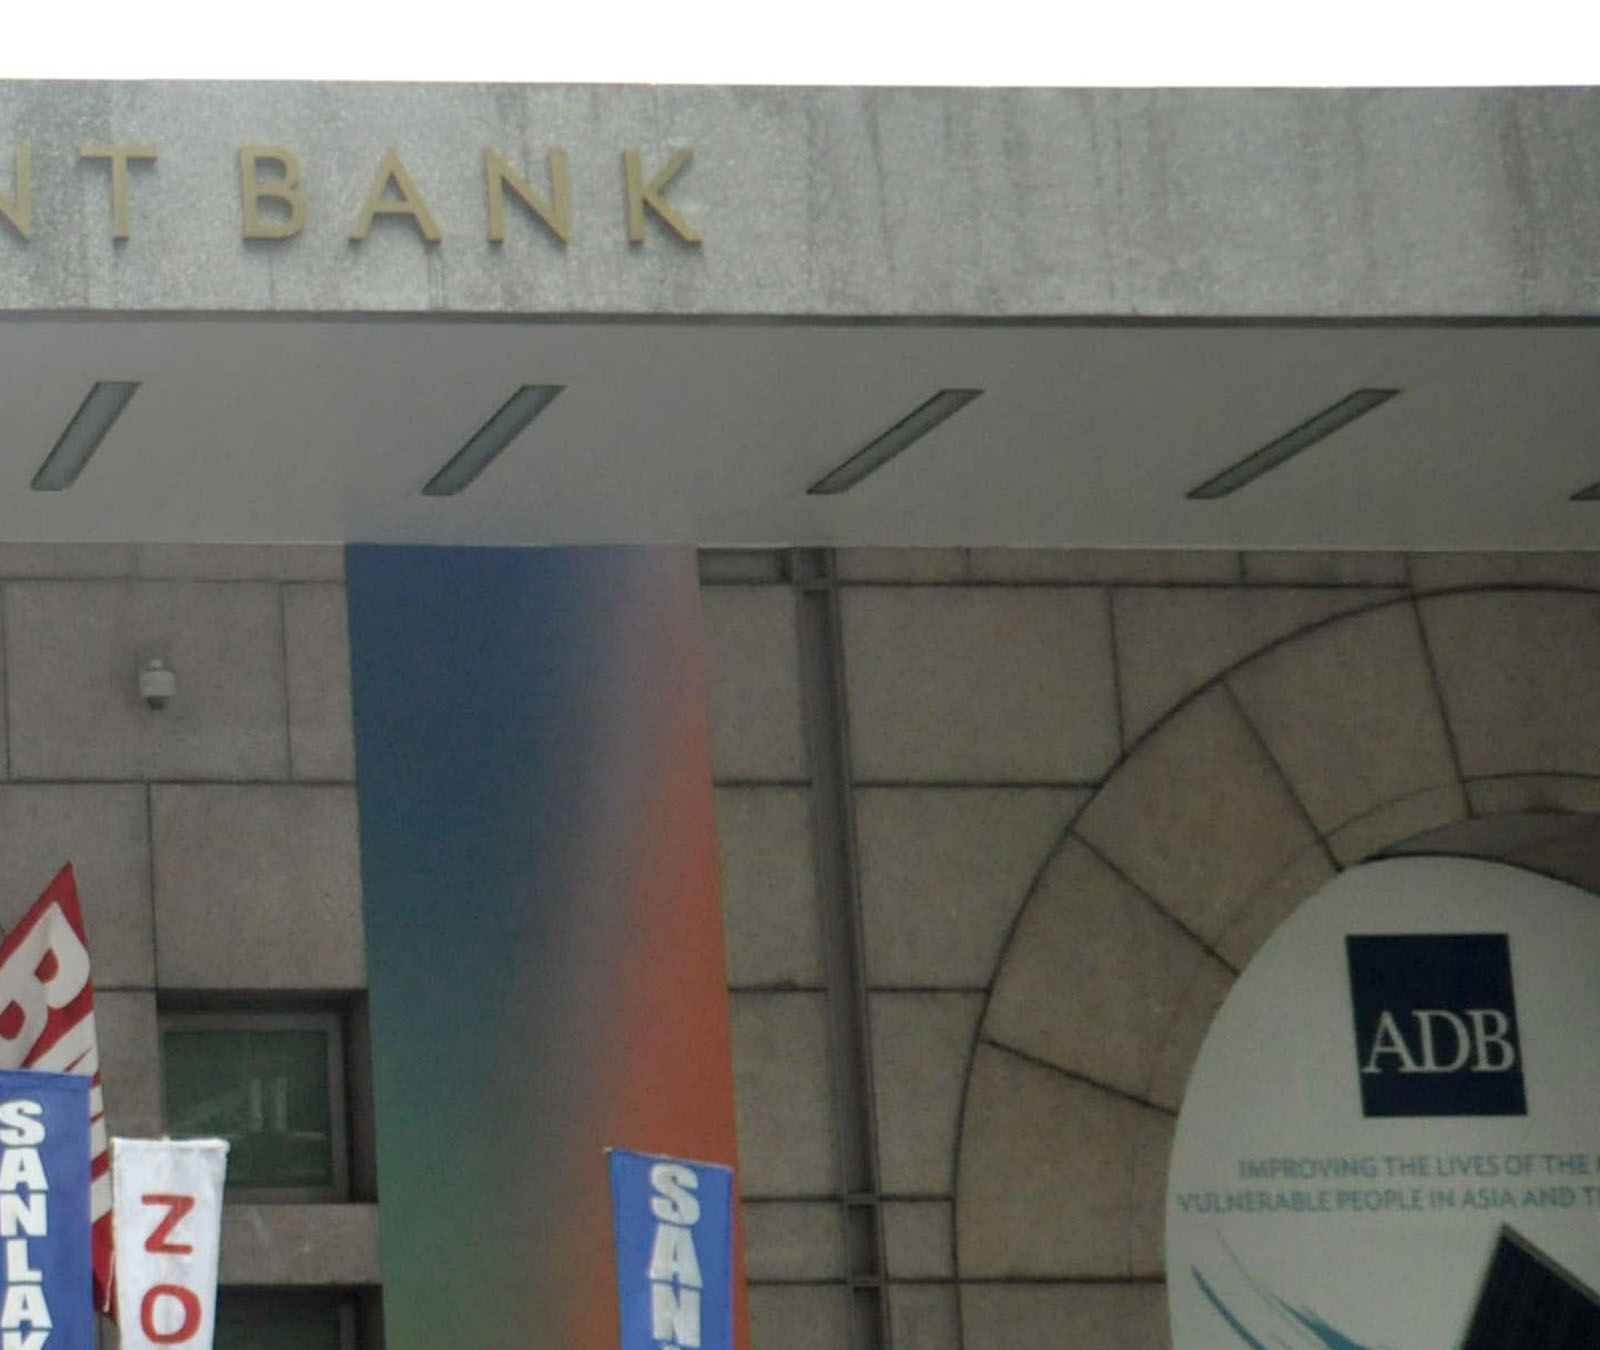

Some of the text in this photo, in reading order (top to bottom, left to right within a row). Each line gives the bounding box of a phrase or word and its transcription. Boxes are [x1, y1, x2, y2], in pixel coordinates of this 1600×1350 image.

[237, 144, 703, 247] BANK
[1360, 1009, 1517, 1075] ADB
[1239, 1153, 1591, 1180] IMPROVING THE LIVES OF THE
[1336, 1188, 1425, 1213] PEOPLE
[1462, 1186, 1517, 1210] ASIA
[1520, 1185, 1577, 1209] AND
